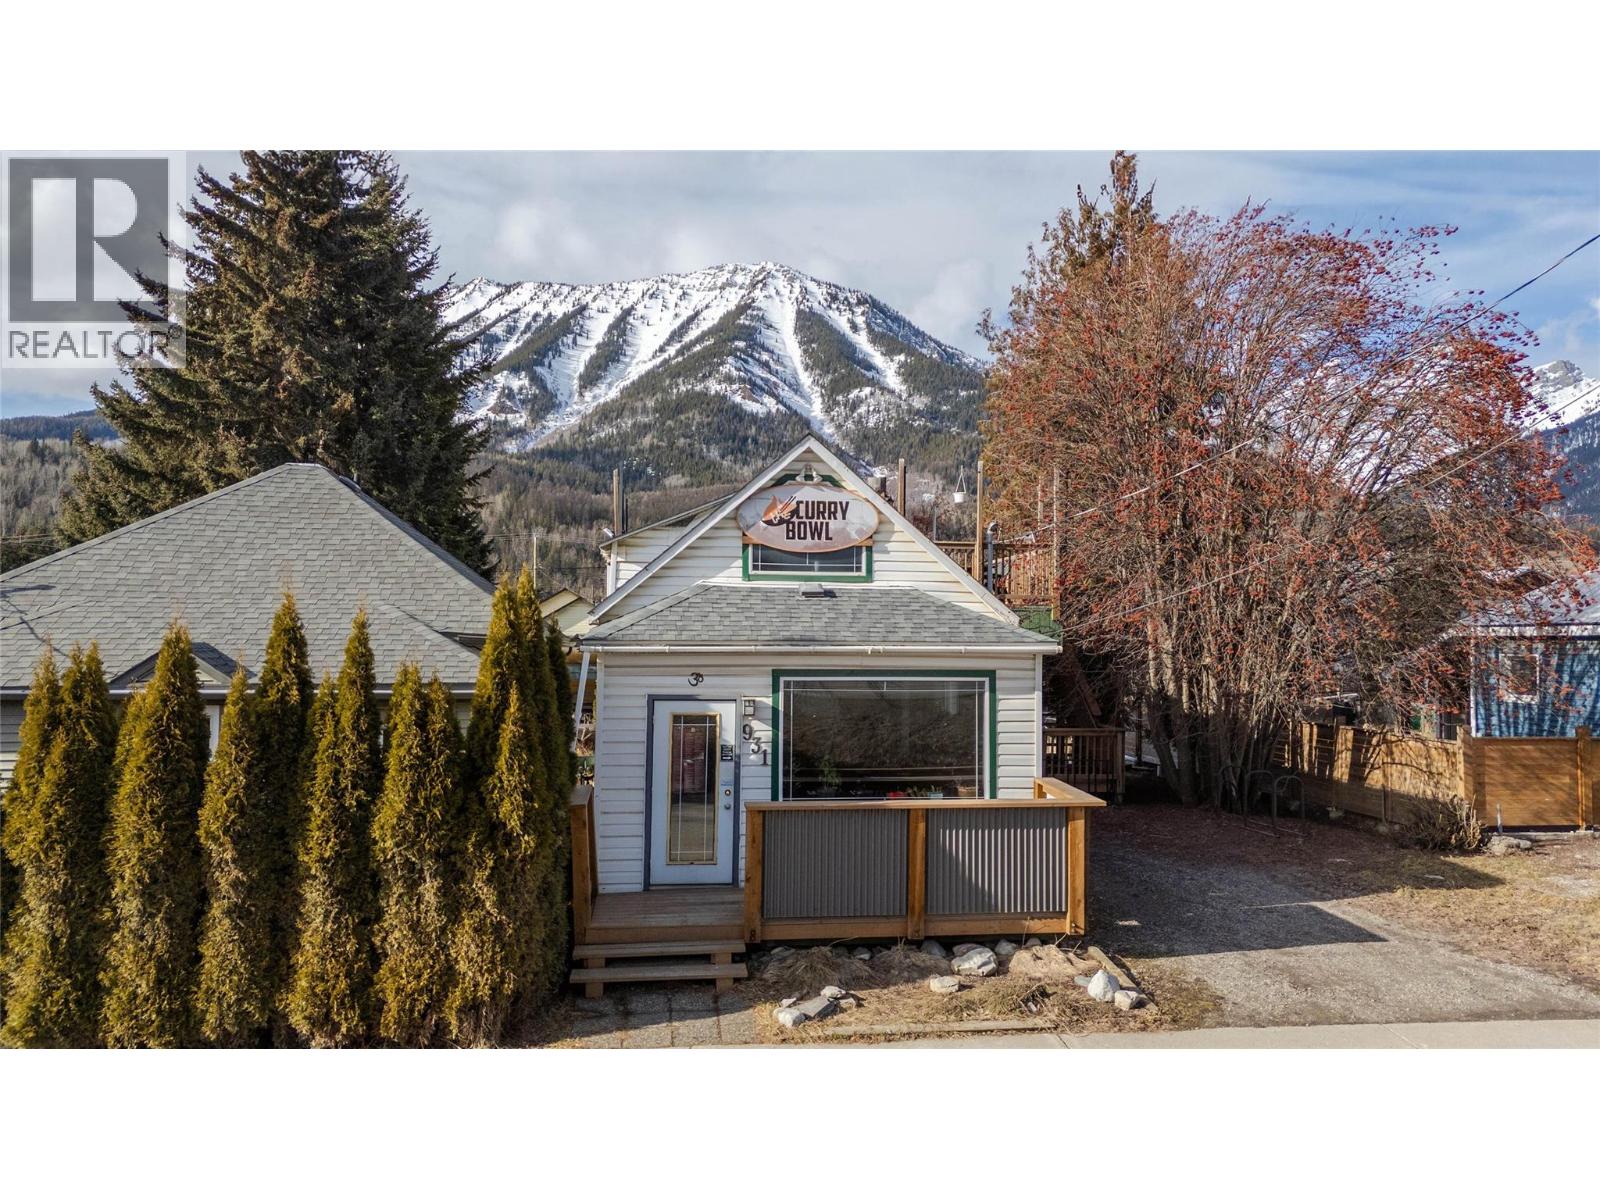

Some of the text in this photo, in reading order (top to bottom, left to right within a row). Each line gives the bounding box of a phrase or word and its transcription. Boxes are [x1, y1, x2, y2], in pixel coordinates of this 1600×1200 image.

[796, 501, 850, 520] CURRY
[785, 521, 833, 541] BOWL
[743, 723, 769, 766] 931
